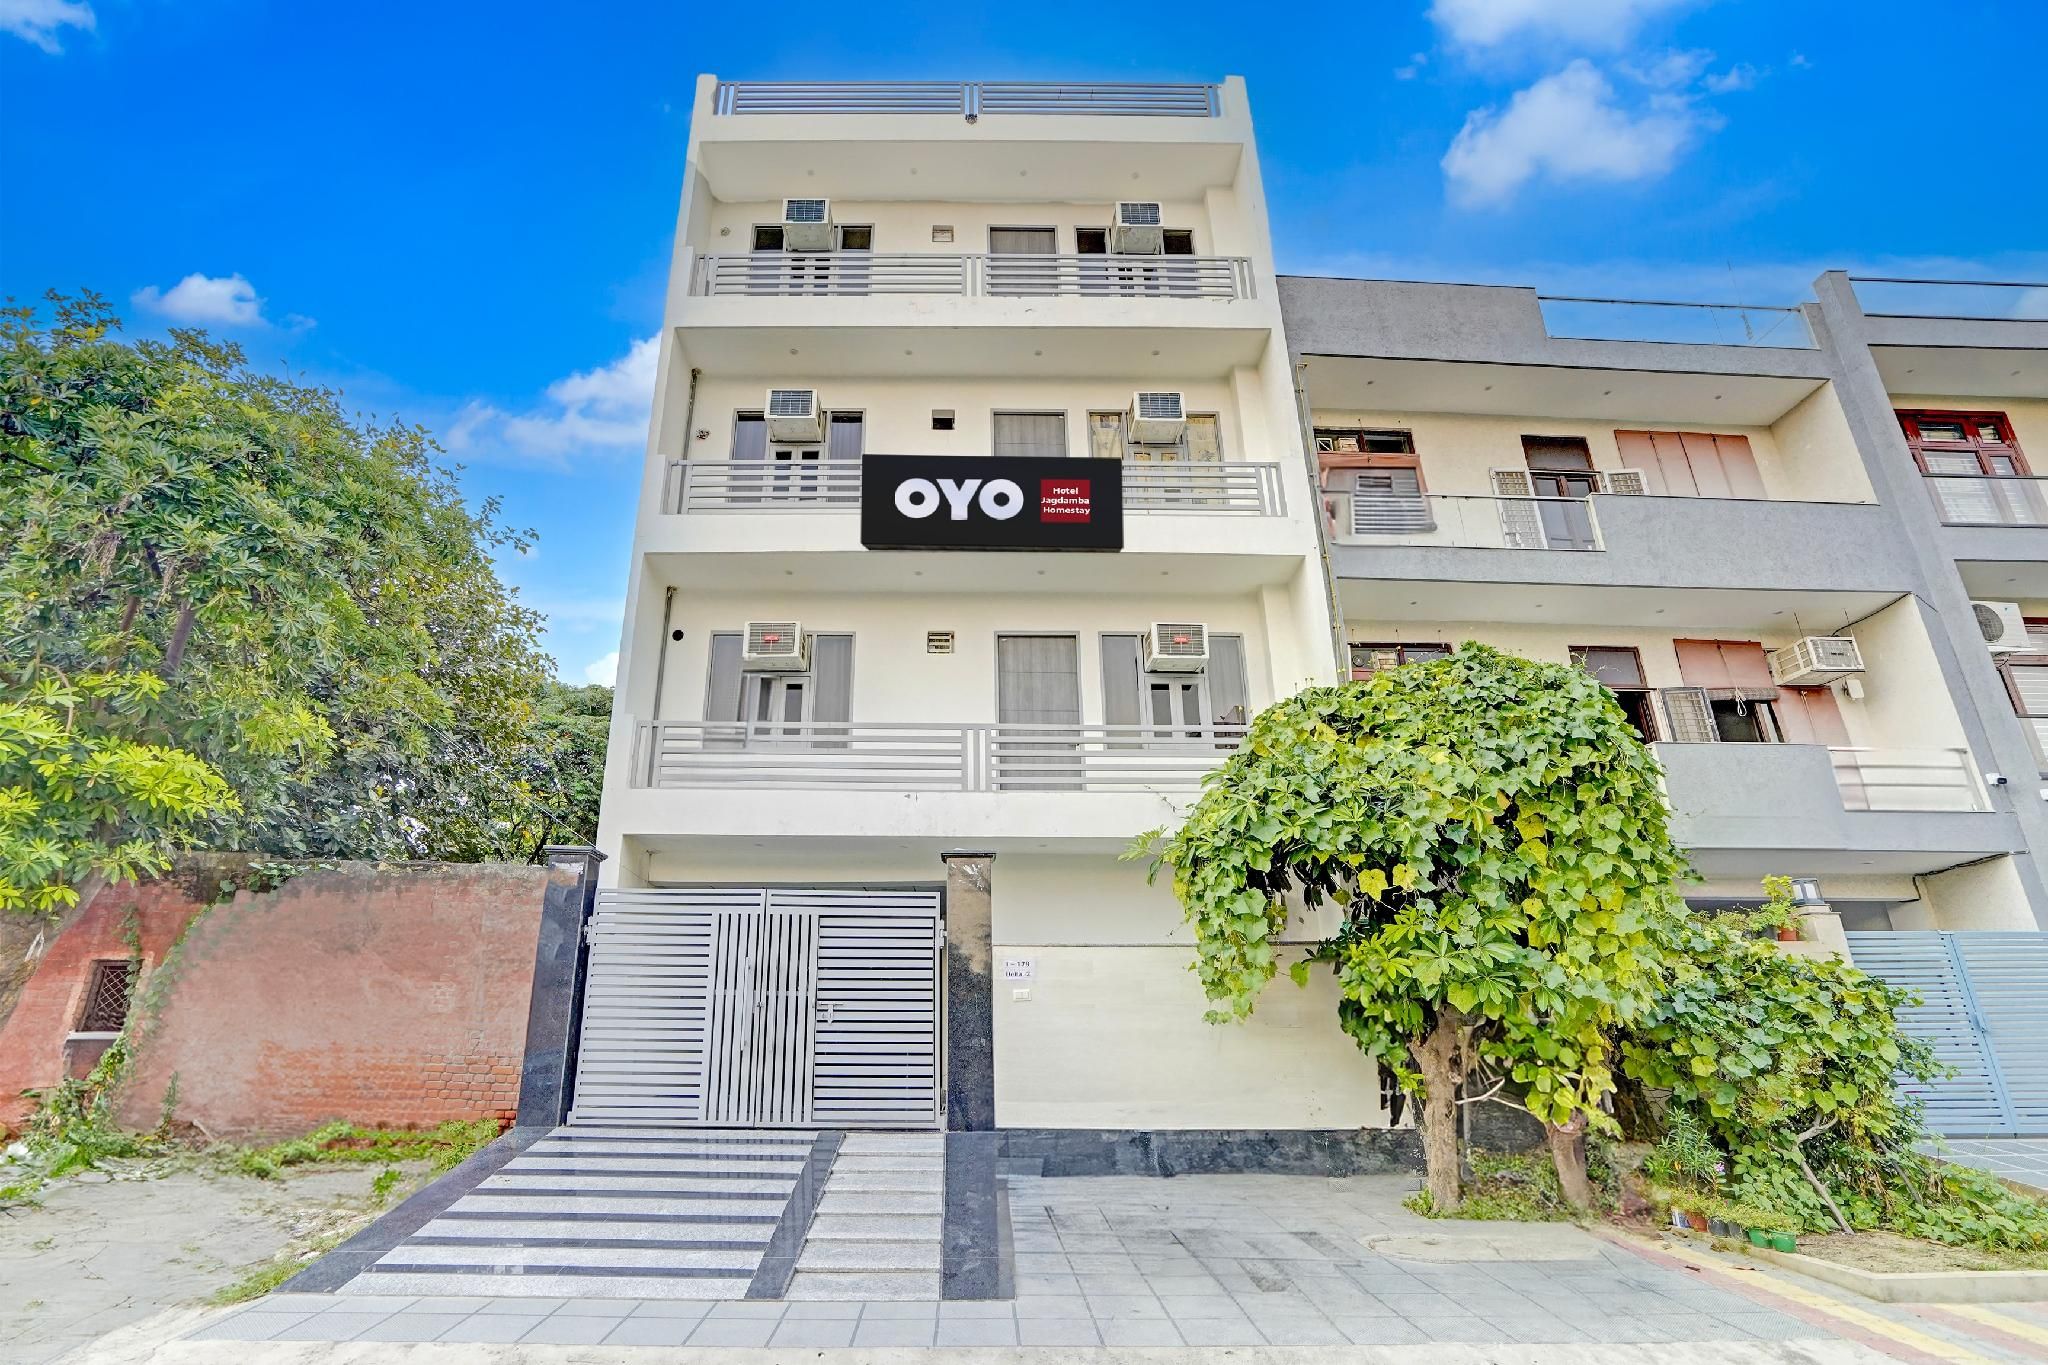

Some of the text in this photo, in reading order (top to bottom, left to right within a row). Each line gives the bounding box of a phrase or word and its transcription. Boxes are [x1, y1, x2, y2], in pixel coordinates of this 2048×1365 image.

[1053, 487, 1079, 495] Hotel
[895, 478, 1024, 520] OYO
[1041, 496, 1090, 505] Jagdamba
[1043, 506, 1091, 515] Homestay
